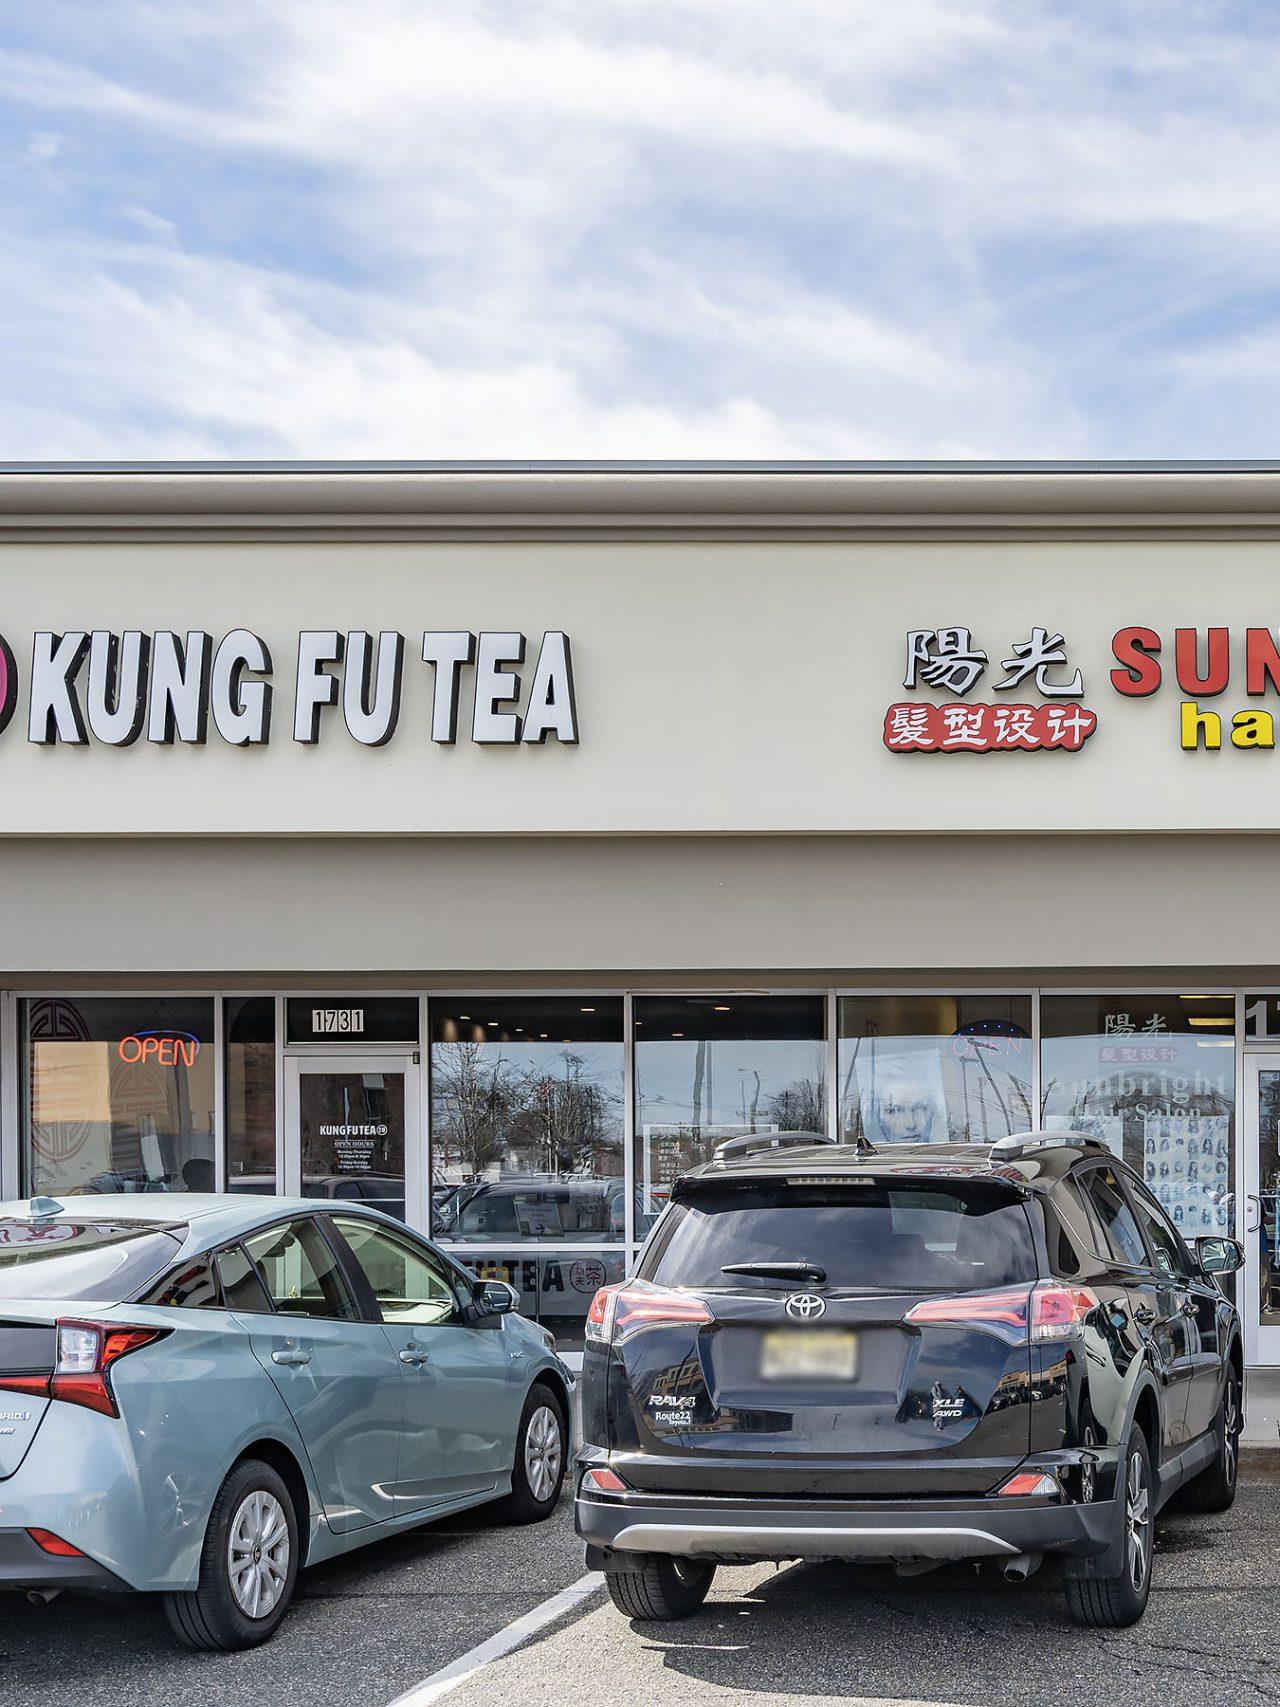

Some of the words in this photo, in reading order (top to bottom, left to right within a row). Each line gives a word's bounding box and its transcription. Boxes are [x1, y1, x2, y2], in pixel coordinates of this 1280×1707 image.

[902, 627, 1084, 698] 陽光
[28, 629, 272, 746] KUNG
[293, 630, 405, 746] FU
[420, 630, 579, 745] TEA
[315, 1010, 363, 1031] 1731
[118, 1036, 196, 1067] OPEN
[320, 1125, 345, 1135] KUNG
[346, 1125, 358, 1135] FU
[359, 1125, 376, 1135] TEA
[648, 1395, 696, 1408] RAV4
[932, 1398, 965, 1408] XLE
[932, 1409, 963, 1418] AWD
